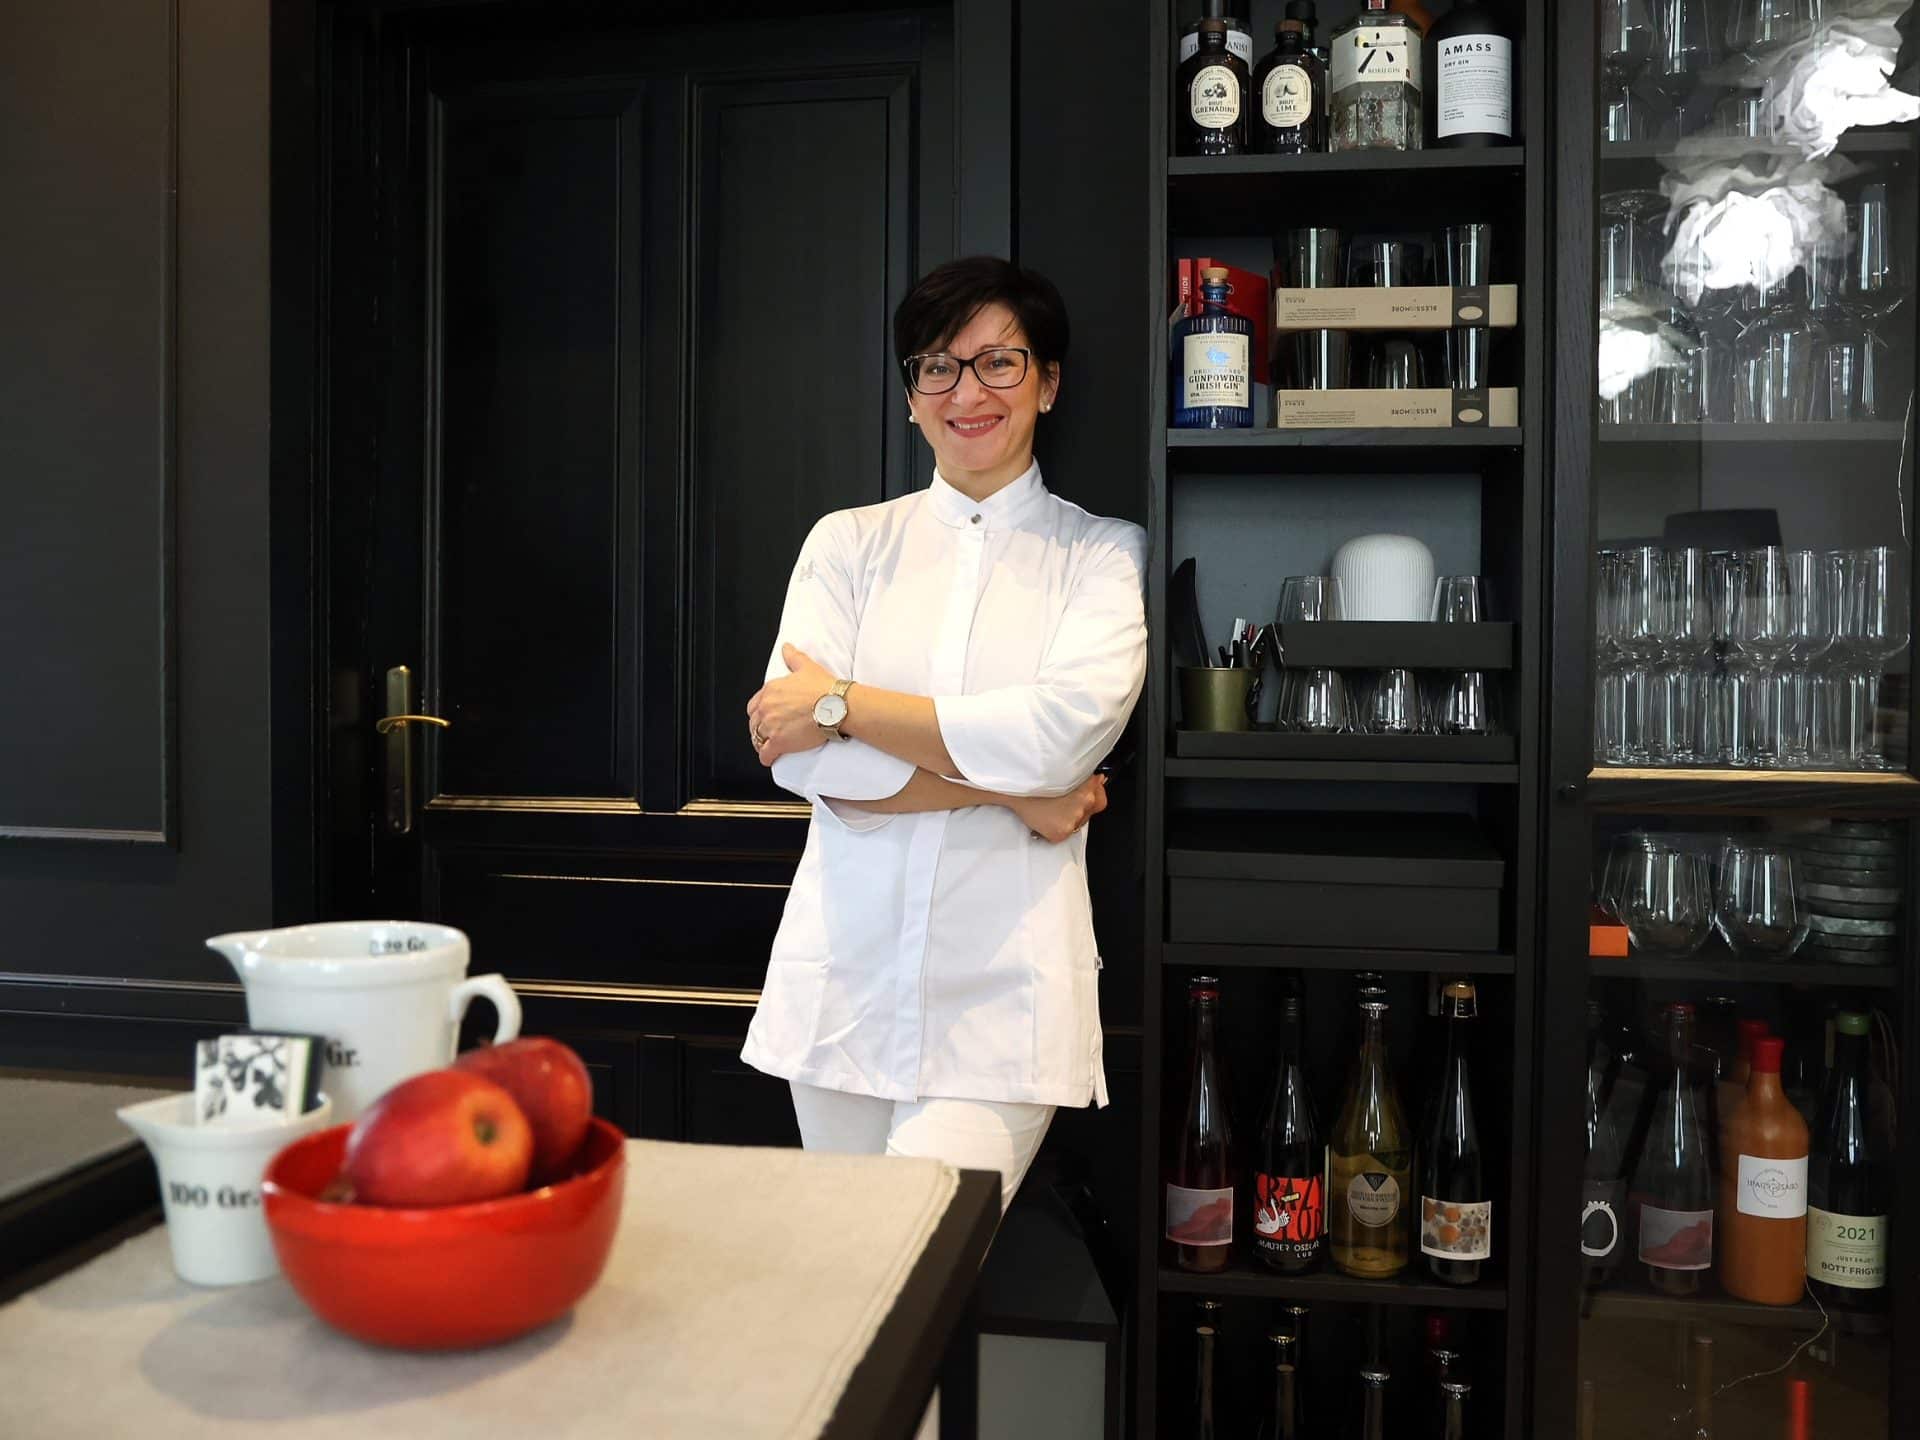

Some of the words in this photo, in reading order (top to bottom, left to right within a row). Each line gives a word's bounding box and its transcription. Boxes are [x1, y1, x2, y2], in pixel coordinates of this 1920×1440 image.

[1444, 42, 1492, 56] AMASS
[1194, 106, 1236, 114] GRENADINE
[1276, 104, 1297, 113] LIME
[1188, 374, 1245, 384] GUNPOWDER
[1196, 382, 1221, 391] IRISH
[1223, 381, 1240, 390] GIN
[169, 1181, 209, 1209] 100
[1836, 1225, 1875, 1241] 2021
[1821, 1261, 1846, 1273] BOTT
